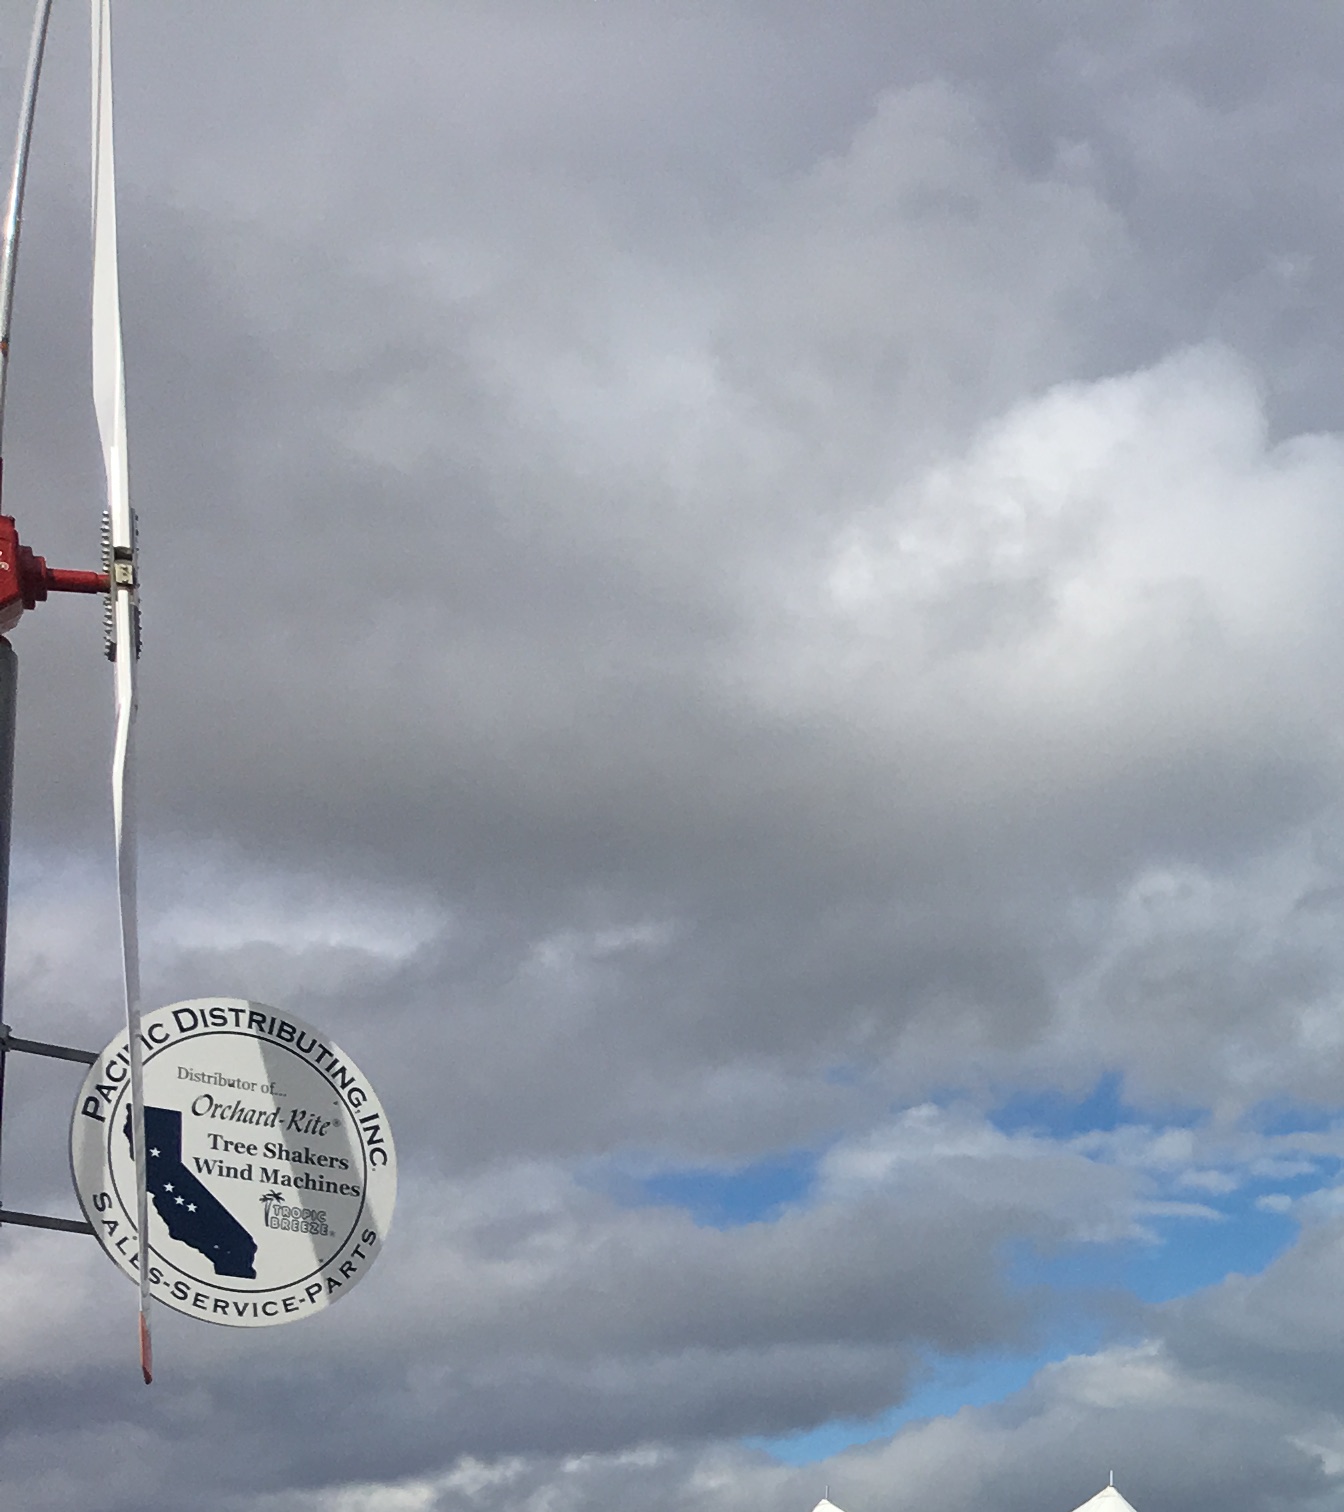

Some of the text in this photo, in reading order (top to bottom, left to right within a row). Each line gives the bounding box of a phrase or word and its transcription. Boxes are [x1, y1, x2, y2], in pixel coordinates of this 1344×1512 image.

[81, 1023, 170, 1122] PACIIC
[177, 1066, 257, 1091] Distributor
[191, 1093, 331, 1137] Orchard-Rite
[207, 1133, 349, 1170] Tree Shakers
[193, 1156, 361, 1197] Wind Machines
[270, 1216, 329, 1236] BREEZE
[272, 1204, 327, 1223] TROPIC
